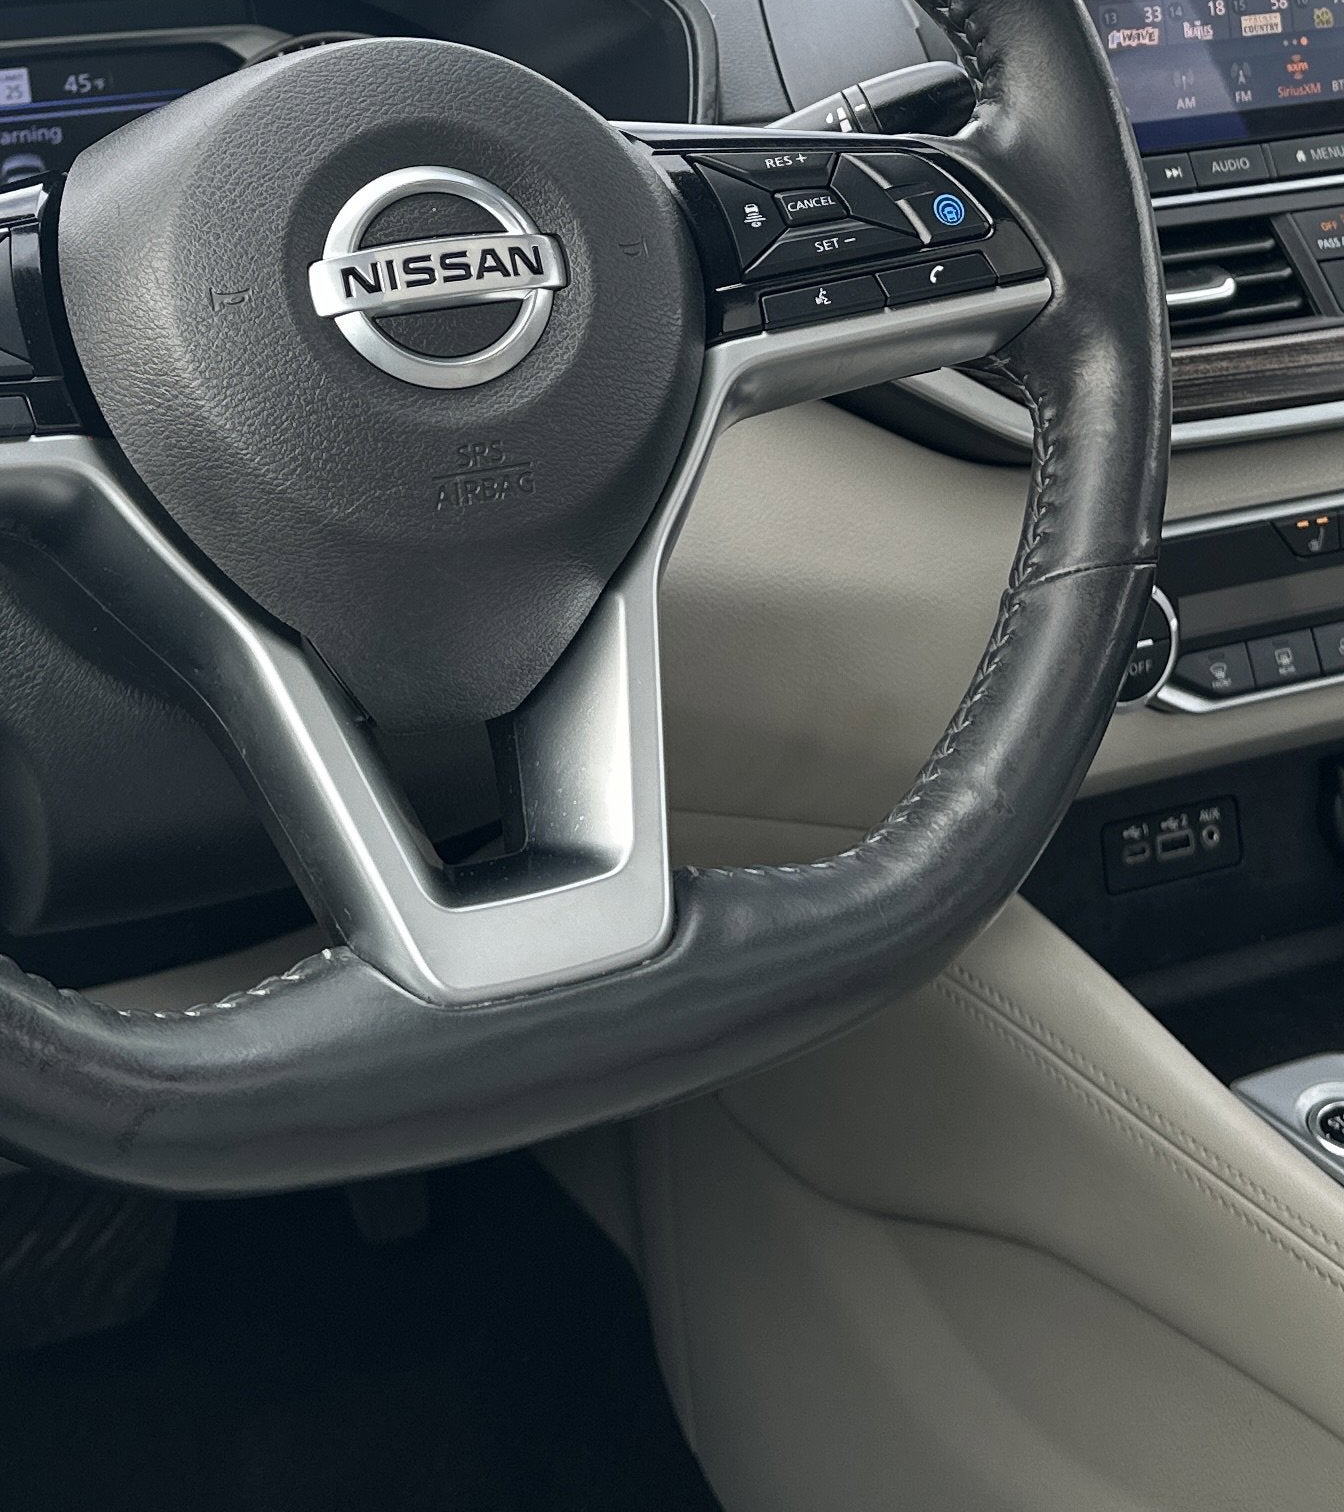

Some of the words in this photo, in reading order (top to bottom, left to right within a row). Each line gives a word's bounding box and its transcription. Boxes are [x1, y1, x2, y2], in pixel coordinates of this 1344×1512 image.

[1143, 6, 1162, 23] 33
[1207, 0, 1226, 16] 18
[1278, 82, 1322, 98] SiriusXM
[1332, 79, 1344, 91] BT
[1176, 96, 1196, 110] AM
[1235, 90, 1252, 103] FM
[764, 155, 793, 169] RES
[1211, 157, 1251, 174] AUDIO
[787, 196, 836, 212] CANCEL
[814, 238, 840, 253] SET
[340, 245, 544, 299] NISSAN
[457, 440, 506, 467] SRS
